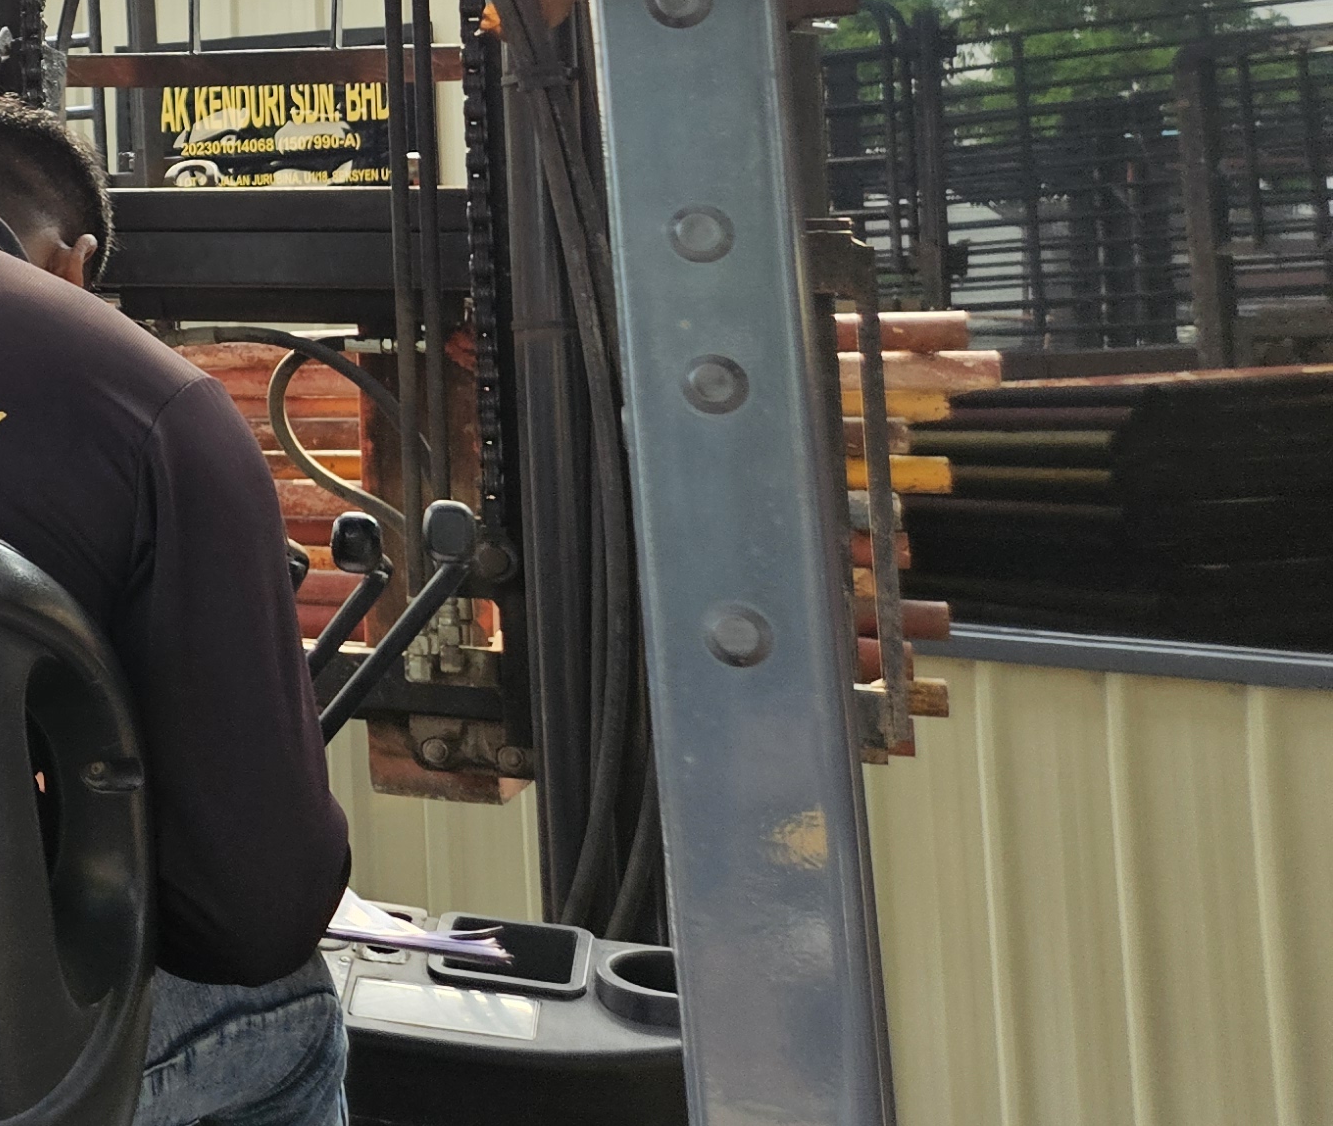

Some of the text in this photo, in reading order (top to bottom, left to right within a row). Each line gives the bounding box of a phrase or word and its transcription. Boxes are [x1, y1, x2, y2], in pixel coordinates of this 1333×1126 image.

[161, 86, 191, 133] AK
[194, 83, 286, 131] KENDURI
[181, 133, 361, 157] 202301014068 (1507990-A)
